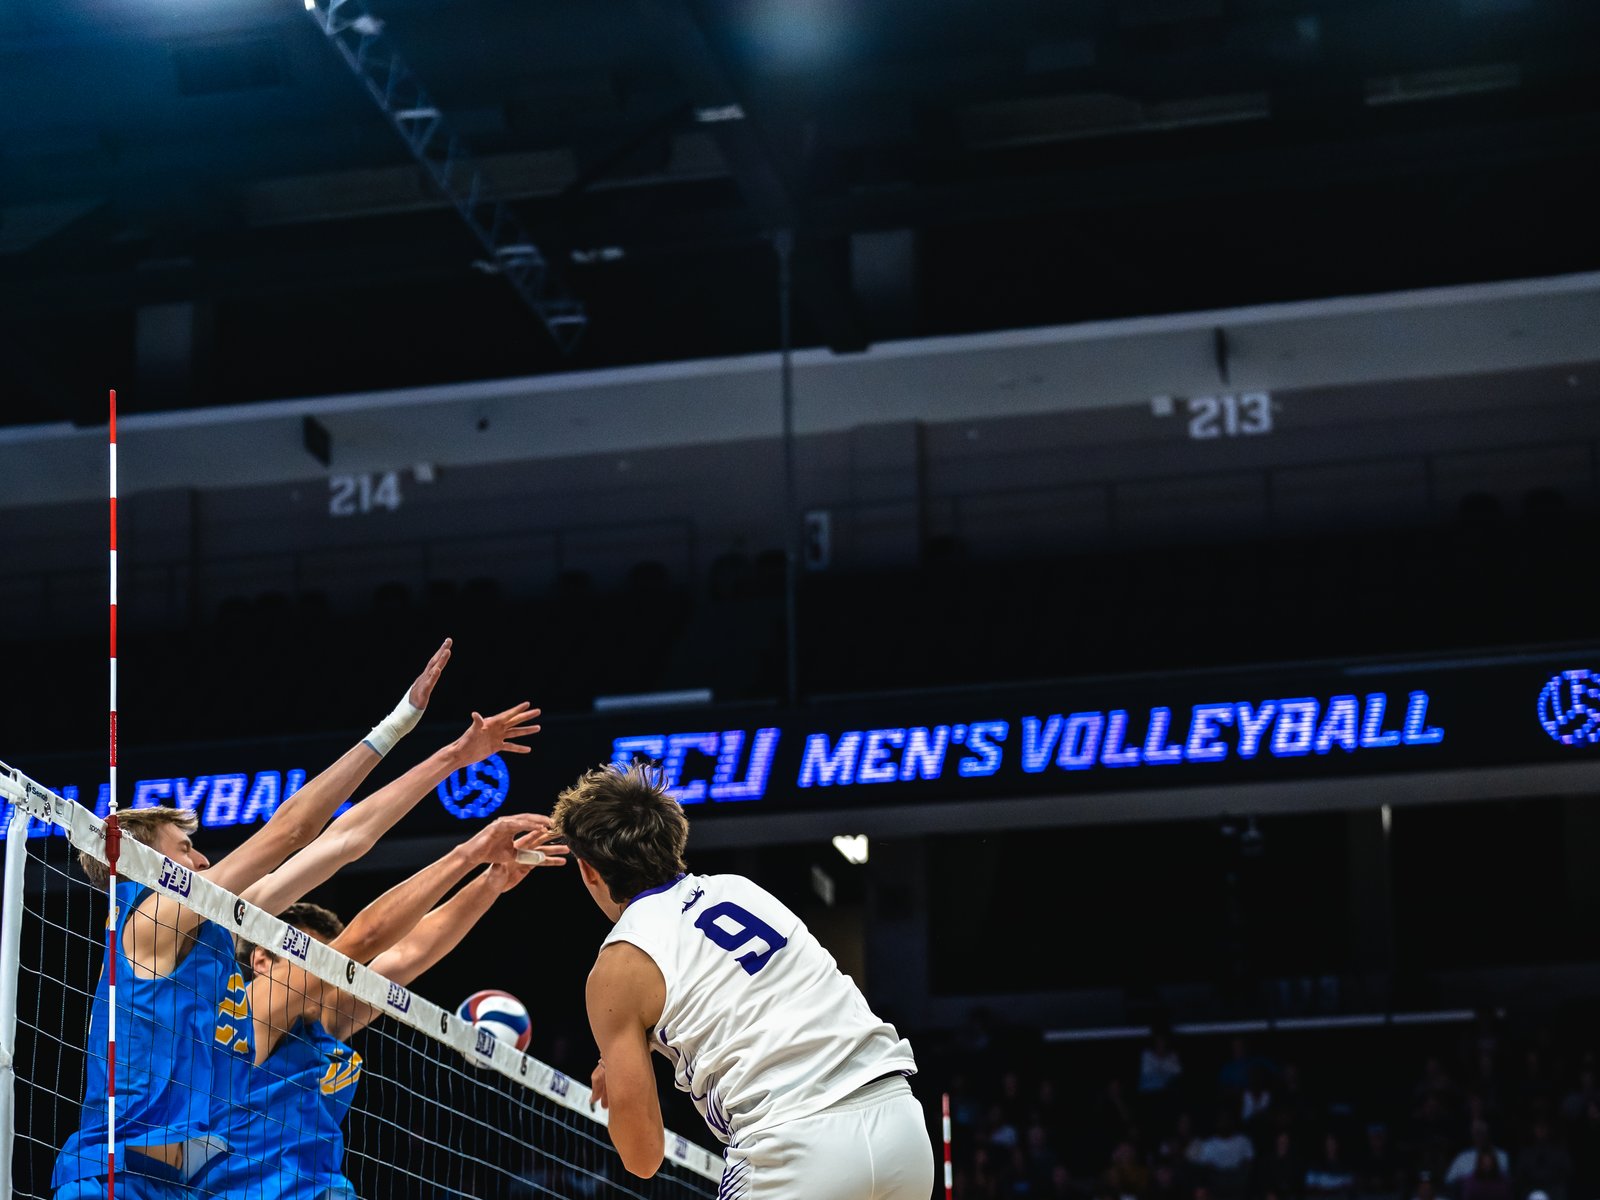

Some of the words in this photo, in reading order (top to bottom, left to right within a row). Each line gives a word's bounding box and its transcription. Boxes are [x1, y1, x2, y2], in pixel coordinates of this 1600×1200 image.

[1189, 392, 1272, 439] 213
[329, 472, 400, 516] 214
[797, 720, 1008, 787] MEN'S
[1020, 690, 1445, 773] VOLLEYBALL
[694, 901, 788, 976] 9
